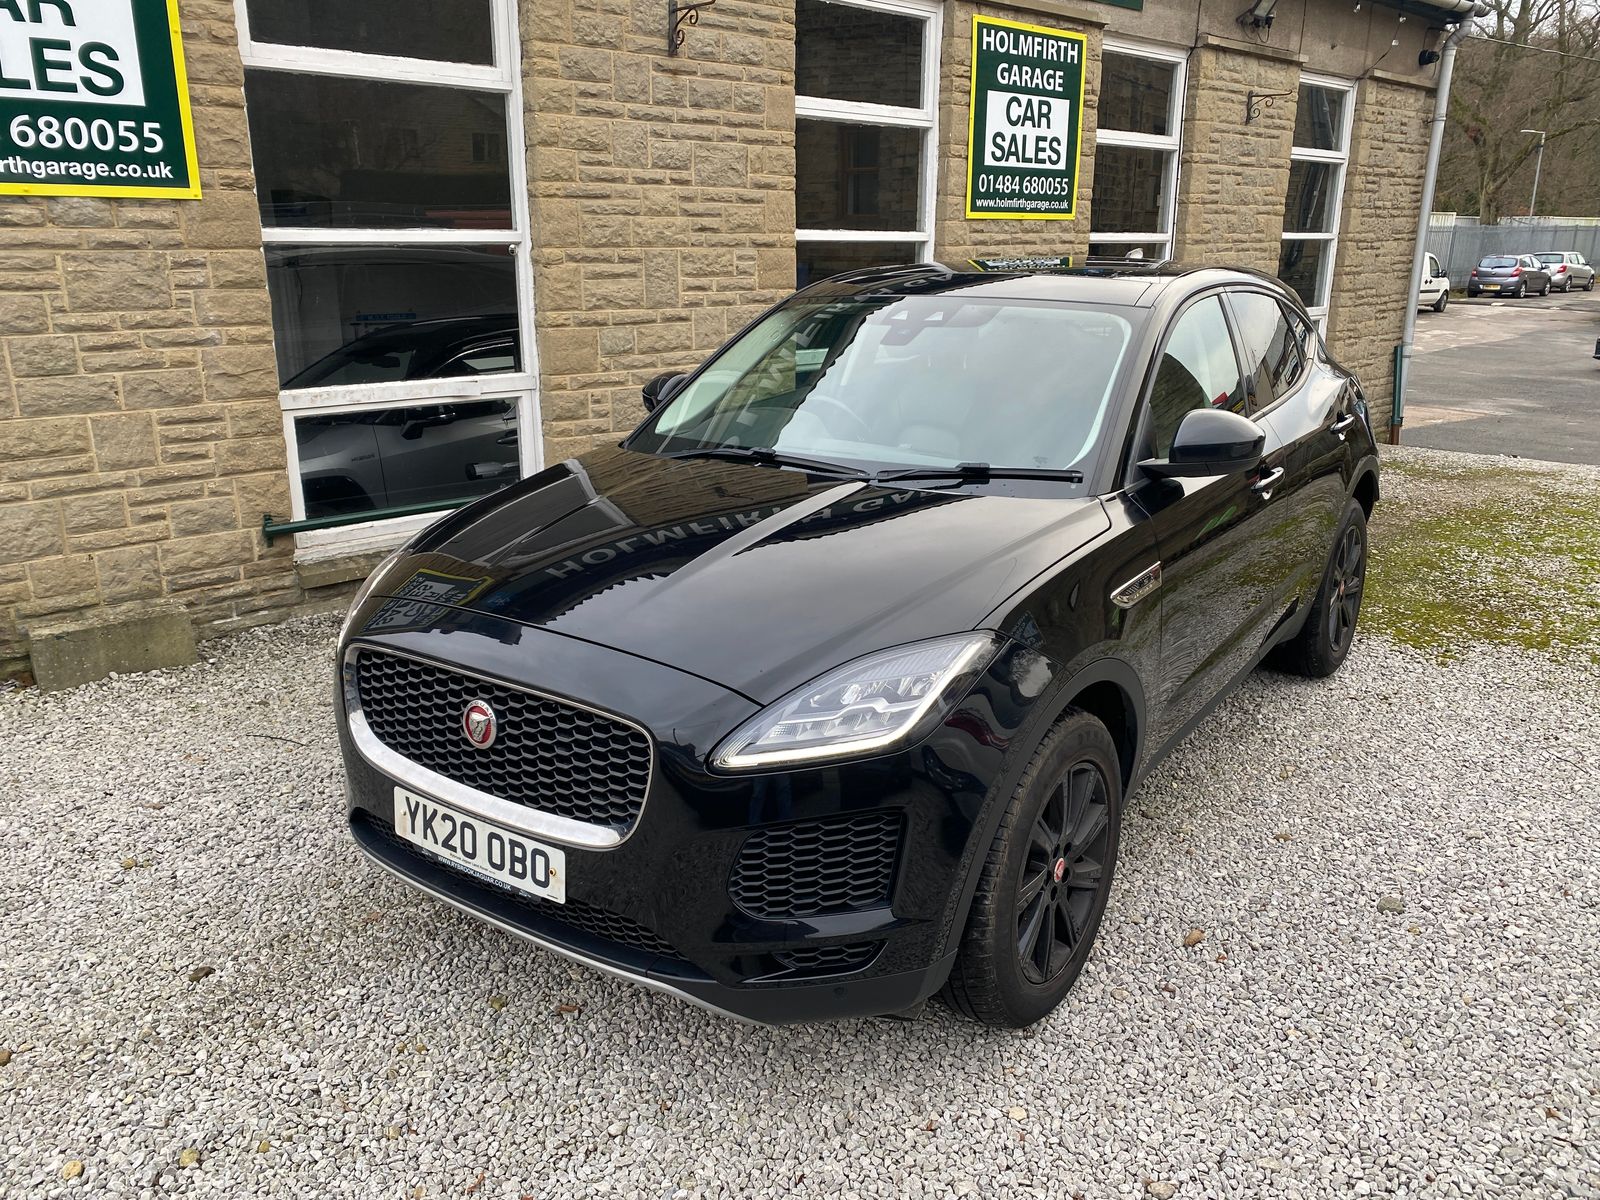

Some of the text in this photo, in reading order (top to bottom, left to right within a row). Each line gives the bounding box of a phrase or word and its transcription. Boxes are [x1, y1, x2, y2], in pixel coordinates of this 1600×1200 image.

[982, 28, 1079, 64] HOLMFIRTH
[996, 62, 1064, 92] GARAGE
[1005, 96, 1052, 129] CAR
[9, 114, 164, 153] 680055
[991, 131, 1062, 166] SALES
[978, 173, 1069, 196] 01484 680055
[975, 197, 1069, 211] www.holmfirthgarage.co.uk
[405, 796, 550, 889] YK20 OBO
